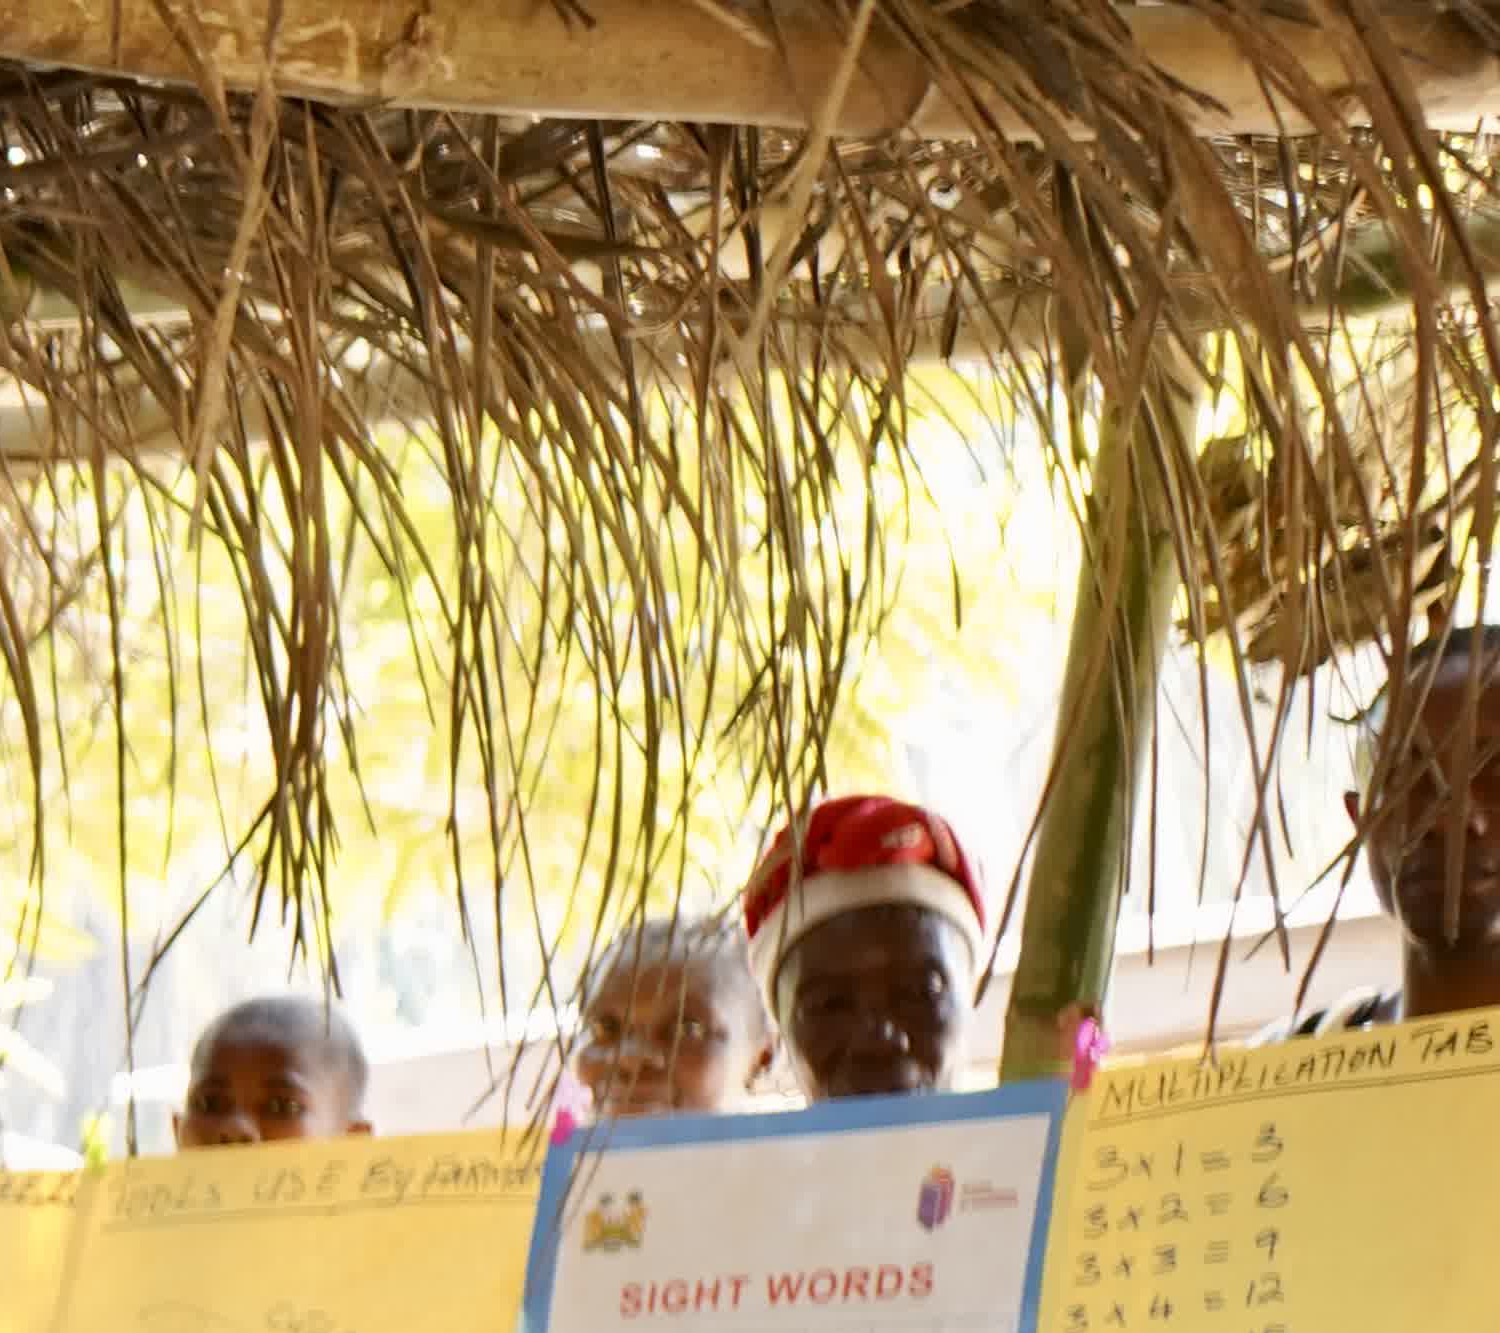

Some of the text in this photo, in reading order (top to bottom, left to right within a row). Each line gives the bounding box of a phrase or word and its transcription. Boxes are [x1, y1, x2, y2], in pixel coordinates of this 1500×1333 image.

[1088, 1144, 1129, 1191] 3
[1173, 1143, 1183, 1177] 1
[1252, 1122, 1284, 1163] 3
[1083, 1203, 1109, 1239] 3
[1158, 1193, 1190, 1224] 2
[1258, 1173, 1290, 1209] 6
[1074, 1253, 1101, 1287] 3
[1152, 1244, 1178, 1275] 3
[1255, 1228, 1280, 1261] 9
[619, 1263, 937, 1320] SIGHT WORDS
[1148, 1295, 1173, 1320] 4
[1245, 1275, 1285, 1308] 12
